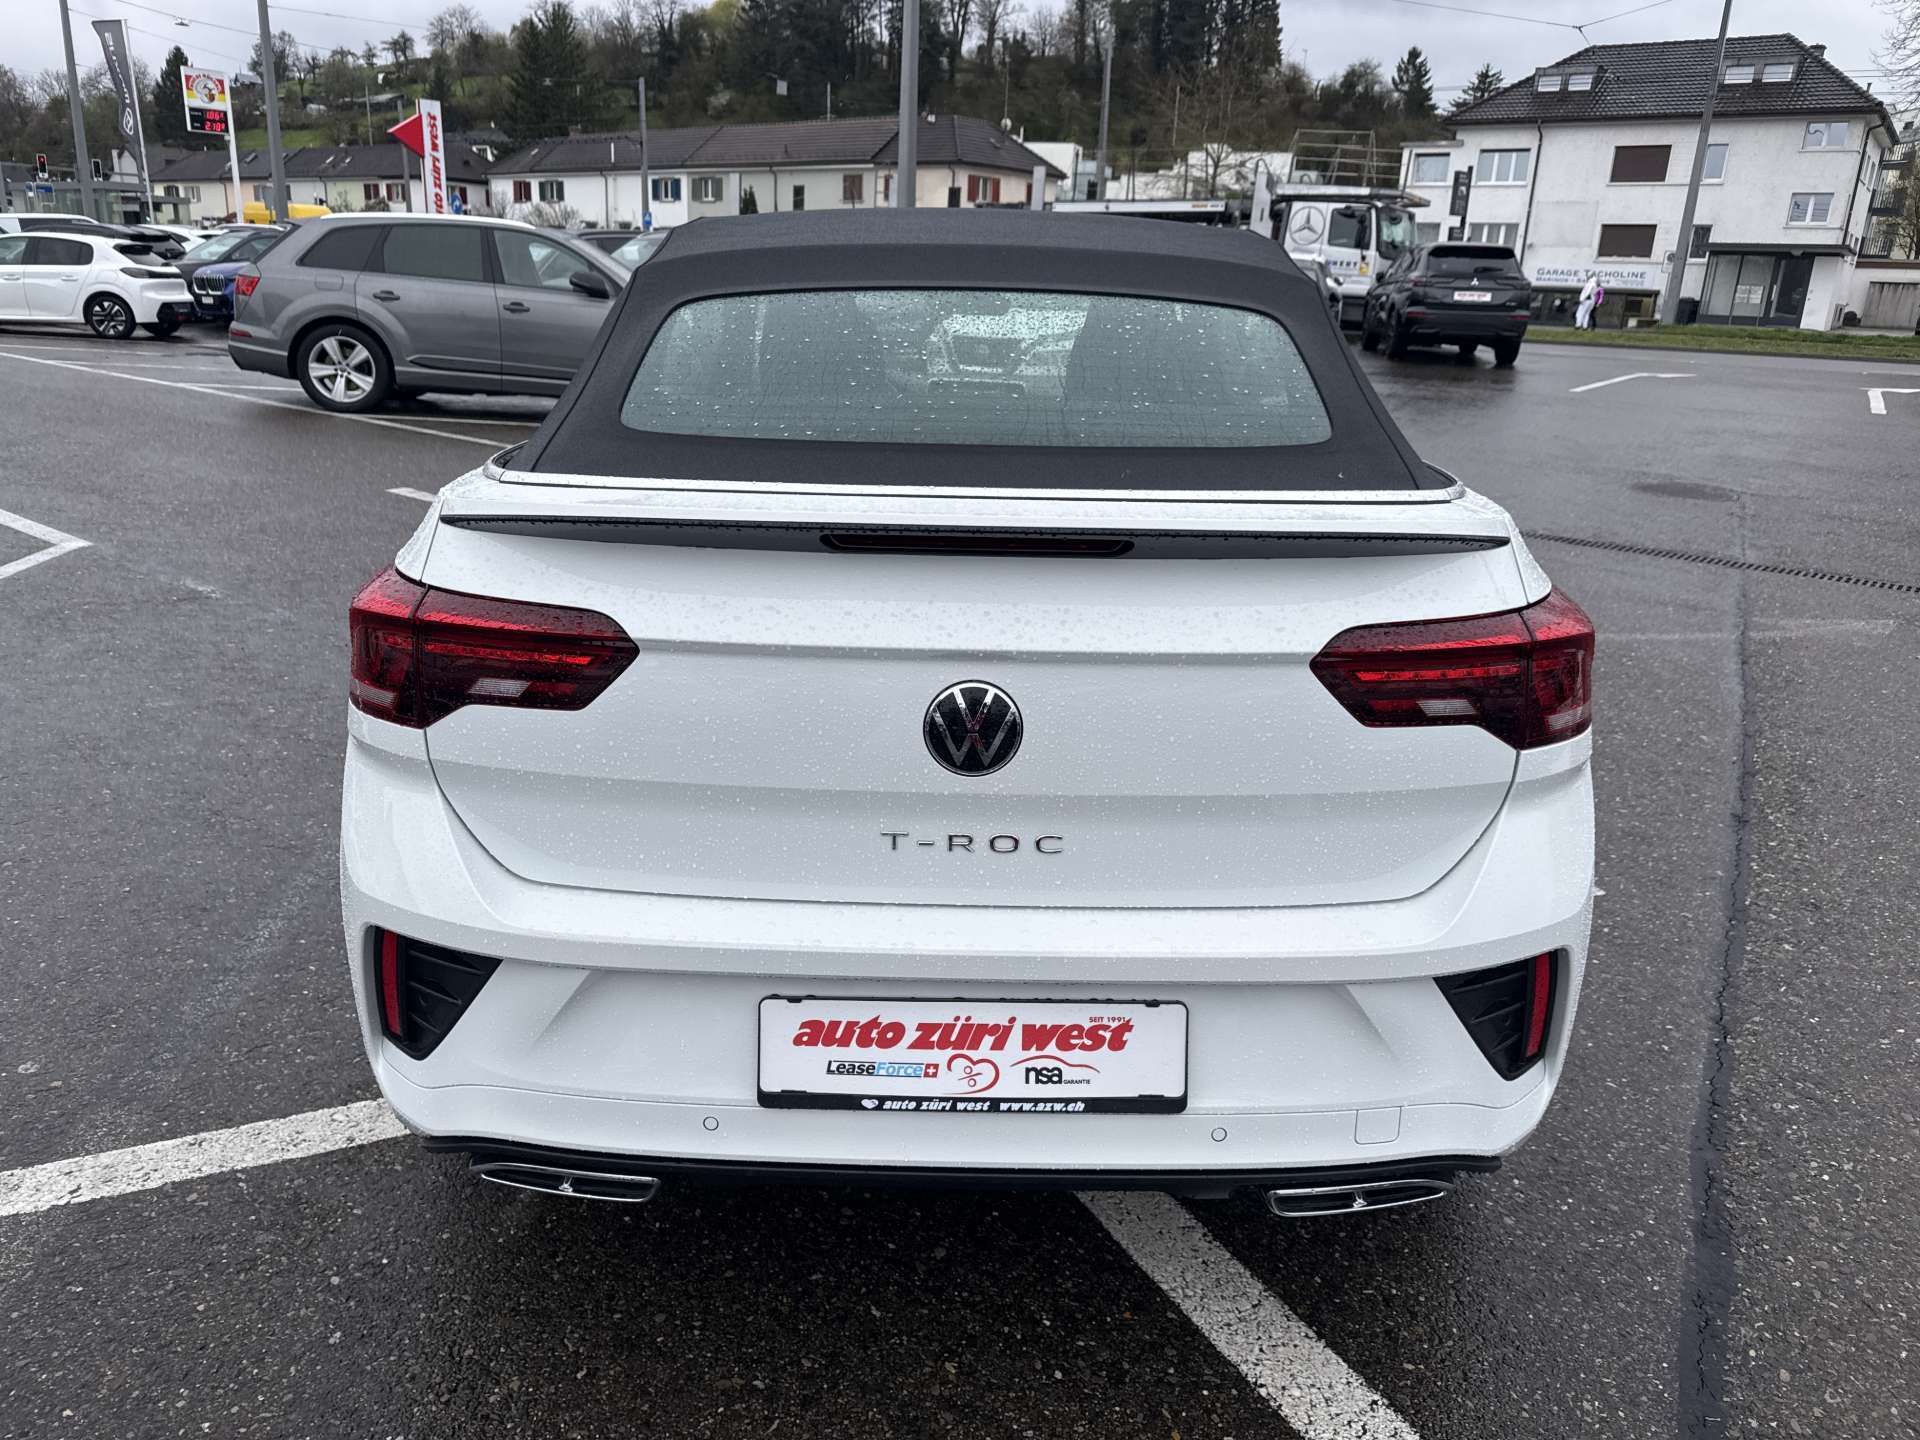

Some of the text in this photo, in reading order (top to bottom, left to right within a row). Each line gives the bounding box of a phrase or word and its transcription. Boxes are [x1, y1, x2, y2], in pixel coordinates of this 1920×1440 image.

[427, 112, 440, 152] west
[880, 831, 1064, 853] T-ROC
[792, 1014, 1135, 1052] auto züri west
[826, 1060, 923, 1077] LeaseForce
[1025, 1066, 1063, 1085] nsa
[882, 1099, 1086, 1112] auto züri west www.azw.ch
